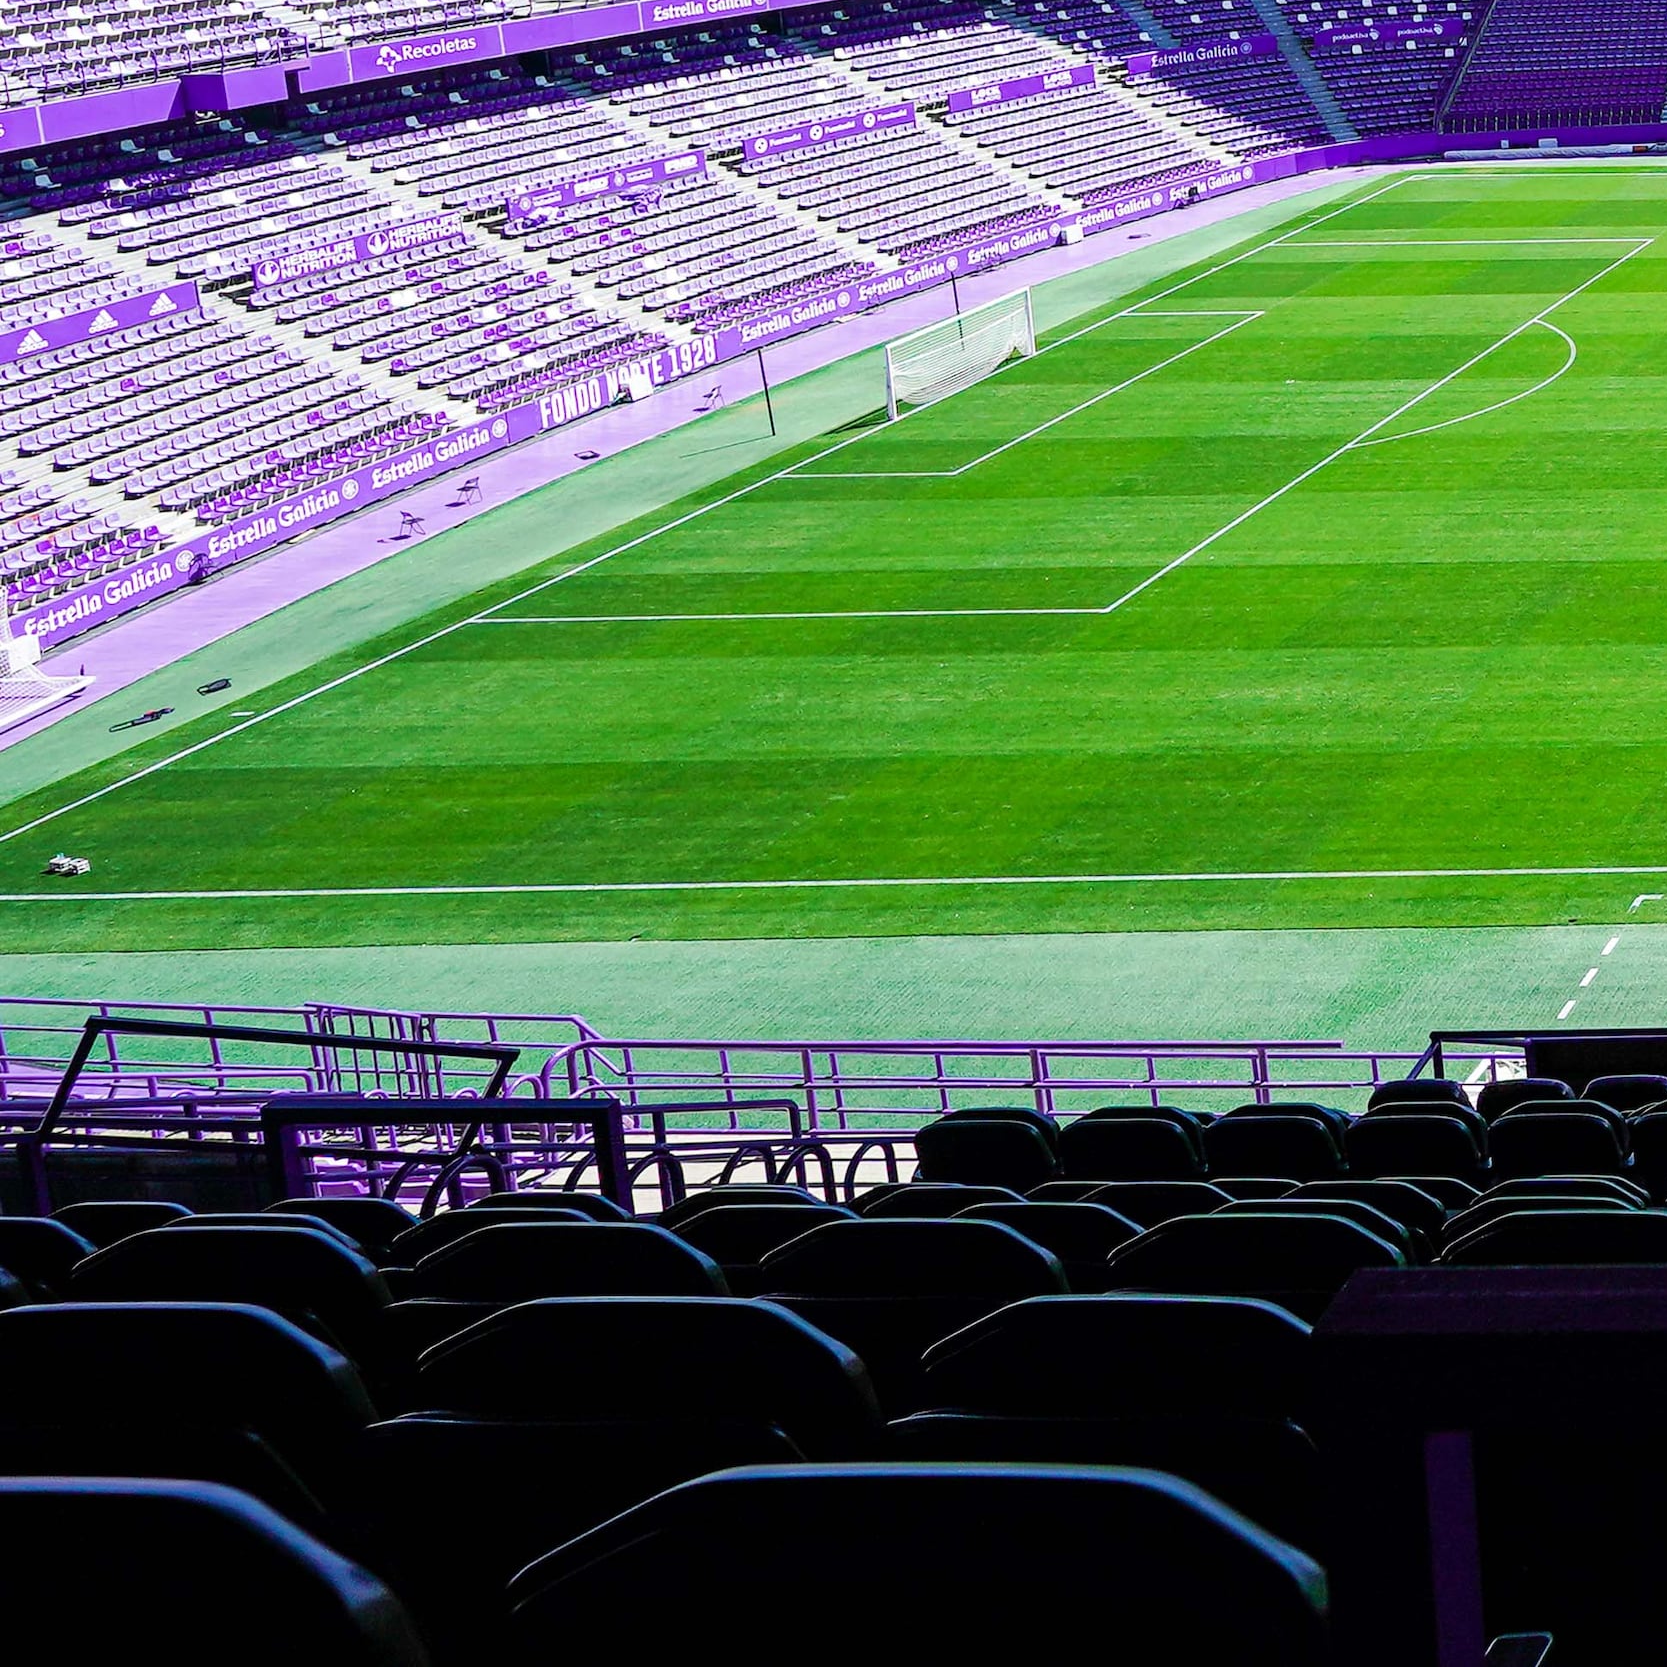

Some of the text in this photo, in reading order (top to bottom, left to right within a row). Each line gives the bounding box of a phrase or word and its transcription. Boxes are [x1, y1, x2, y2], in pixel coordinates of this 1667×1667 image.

[652, 1, 704, 21] Estrella
[401, 35, 477, 60] Recoletas
[1150, 43, 1238, 69] Estrella Galicia
[1207, 171, 1242, 190] Galicia
[388, 215, 462, 240] HERBALIFE
[1075, 196, 1151, 229] Estrella Galicia
[390, 223, 462, 250] NUTRITION
[967, 229, 1049, 264] Estrella Galicia
[279, 240, 355, 269] HERBALIFE
[281, 248, 357, 280] NUTRITION
[857, 260, 945, 303] Estrella Galicia
[740, 298, 837, 343] Estrella Galicia
[538, 384, 602, 428] FONDO
[667, 333, 717, 378] 1928
[371, 427, 491, 490] Estrella Galicia
[207, 490, 341, 559] Estrella Galicia
[24, 561, 173, 637] Estrella Galicia
